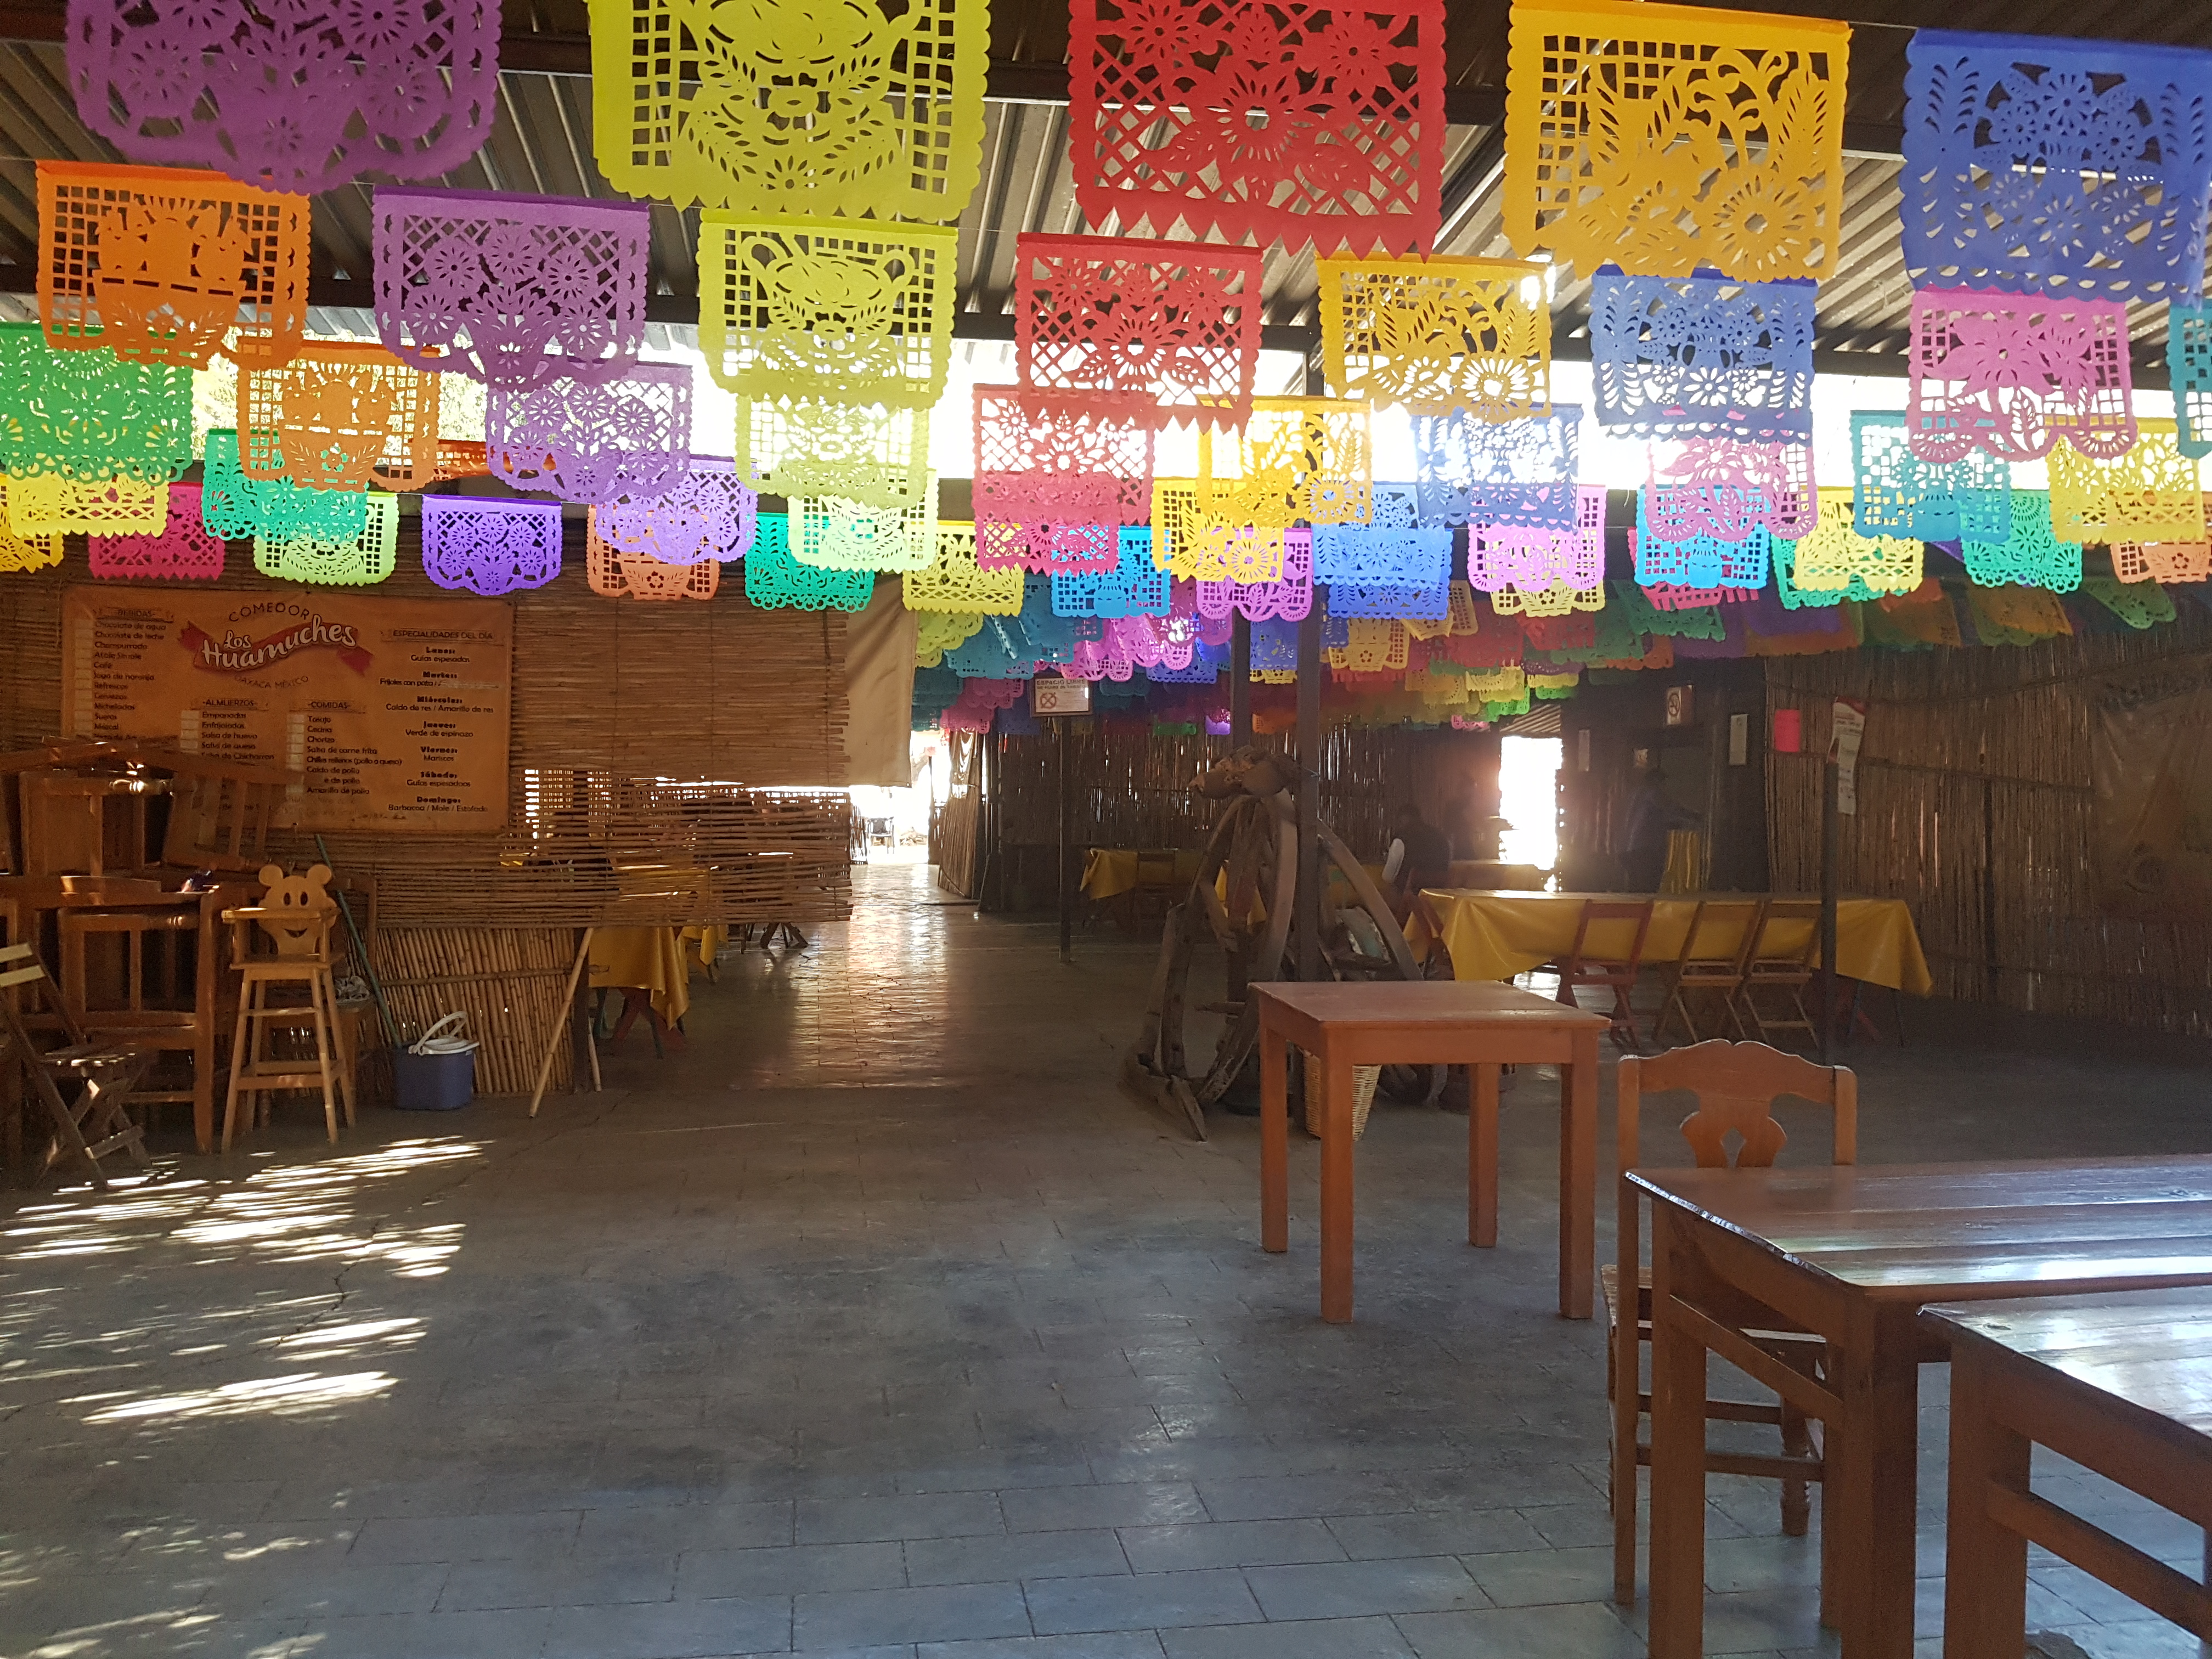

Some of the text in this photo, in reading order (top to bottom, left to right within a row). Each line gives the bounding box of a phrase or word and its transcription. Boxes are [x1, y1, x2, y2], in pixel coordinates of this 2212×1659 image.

[228, 601, 311, 622] COMEDOR
[223, 629, 252, 648] Los
[393, 630, 459, 639] ESPECIALIDADES
[478, 631, 493, 640] DÍA
[94, 641, 148, 650] Champurrado
[200, 613, 357, 669] Huamuches
[93, 670, 111, 680] Jugo
[125, 673, 155, 681] naranja
[94, 681, 128, 690] Refrescos
[235, 674, 272, 689] OAXACA
[94, 703, 136, 711] Micheladas
[386, 703, 408, 711] Caldo
[438, 704, 470, 713] Amarillo
[202, 712, 246, 720] Empanadas
[308, 715, 331, 725] Tasajo
[202, 721, 245, 730] Enfrijoladas
[422, 720, 456, 729] Jueves:
[420, 746, 459, 754] Viernes:
[354, 758, 373, 766] (pollo
[380, 758, 403, 766] queso)
[423, 754, 454, 762] Mariscos
[416, 795, 461, 804] Domingo:
